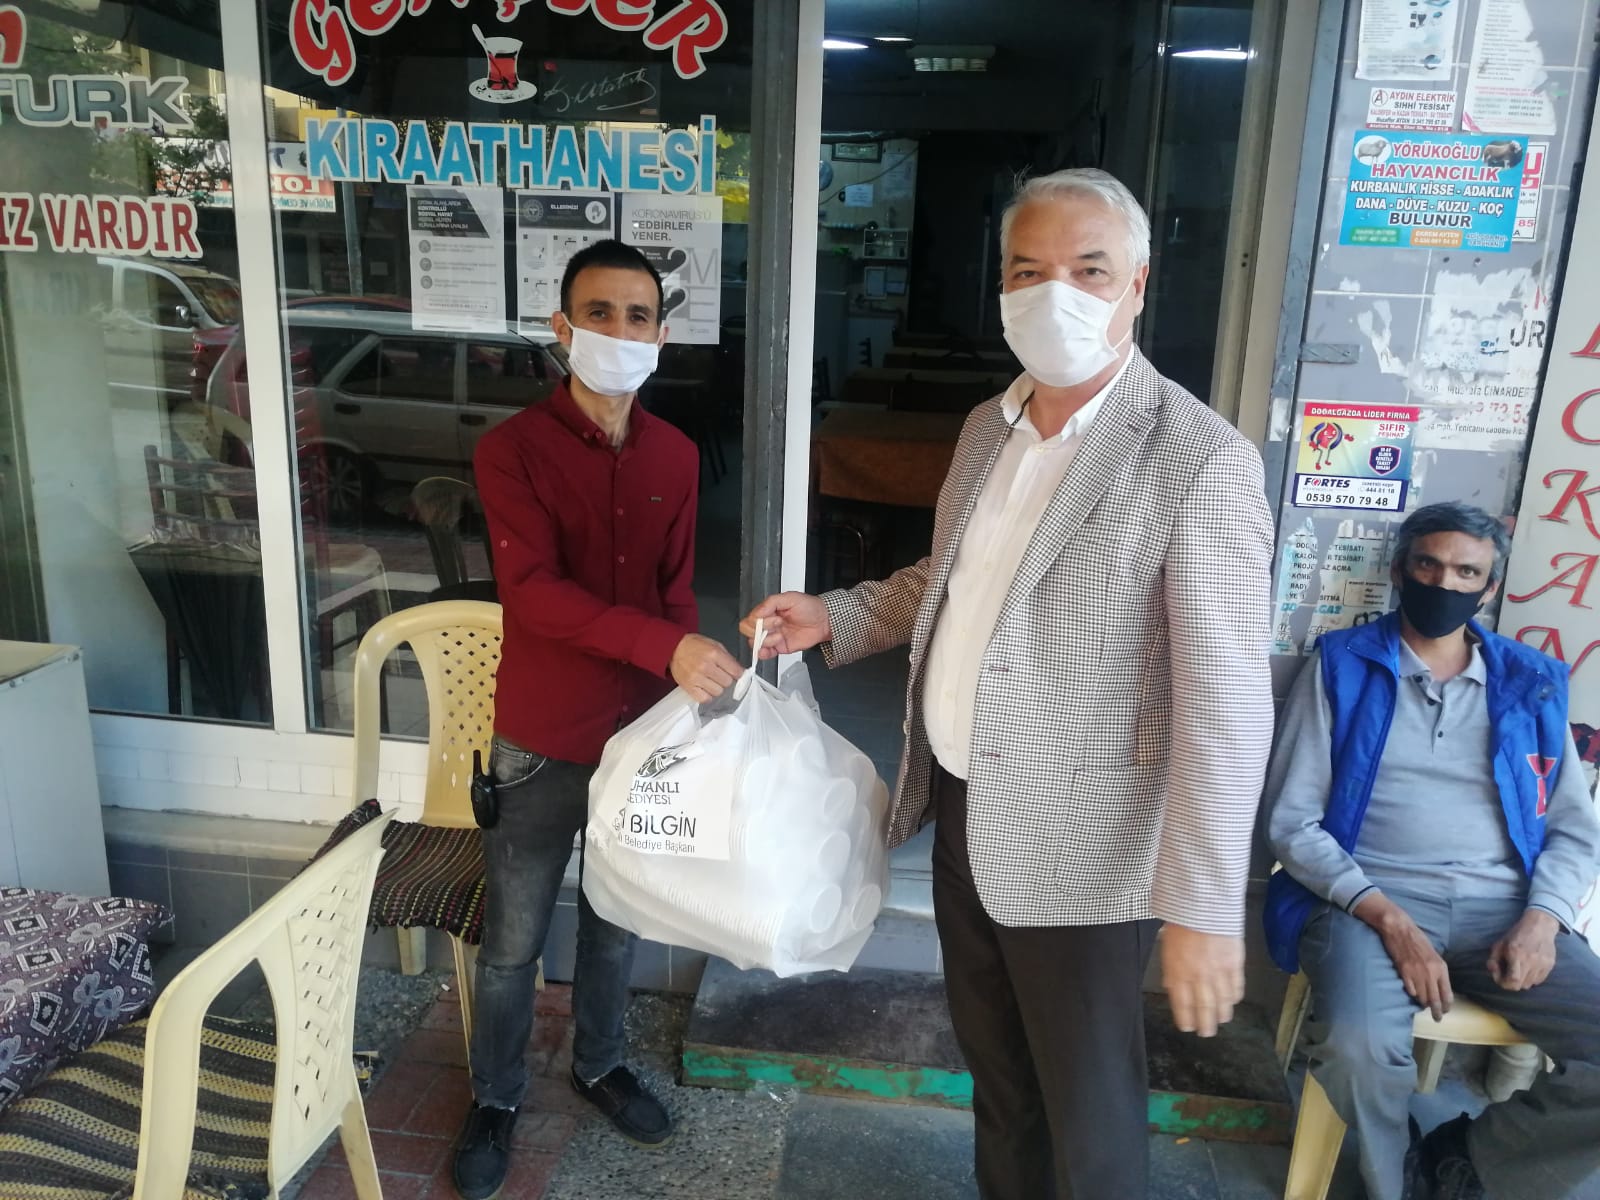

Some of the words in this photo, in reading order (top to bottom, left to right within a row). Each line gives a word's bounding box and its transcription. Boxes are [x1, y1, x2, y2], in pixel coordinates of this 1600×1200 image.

[1389, 91, 1415, 101] AYDIN
[304, 115, 717, 196] KIRAATHANESİ
[1392, 141, 1481, 161] YÖRÜKOĞLU
[1371, 163, 1500, 182] HAYVANCILIK
[1350, 181, 1417, 195] KURBANLIK
[1420, 182, 1455, 196] HİSSE
[1463, 184, 1514, 198] ADAKLIK
[1355, 198, 1386, 210] DANA
[1396, 197, 1427, 212] DÜVE
[1437, 200, 1470, 213] KUZU
[1478, 202, 1504, 217] KOÇ
[41, 197, 201, 256] VARDIR
[1389, 213, 1472, 227] BULUNUR
[1378, 423, 1405, 432] SIFIR
[1304, 477, 1351, 488] FORTES
[1306, 493, 1332, 503] 0539
[1336, 495, 1355, 504] 570
[1359, 496, 1372, 505] 79
[1375, 497, 1388, 506] 48
[630, 810, 696, 838] BİLGİN
[624, 834, 662, 851] Belediye
